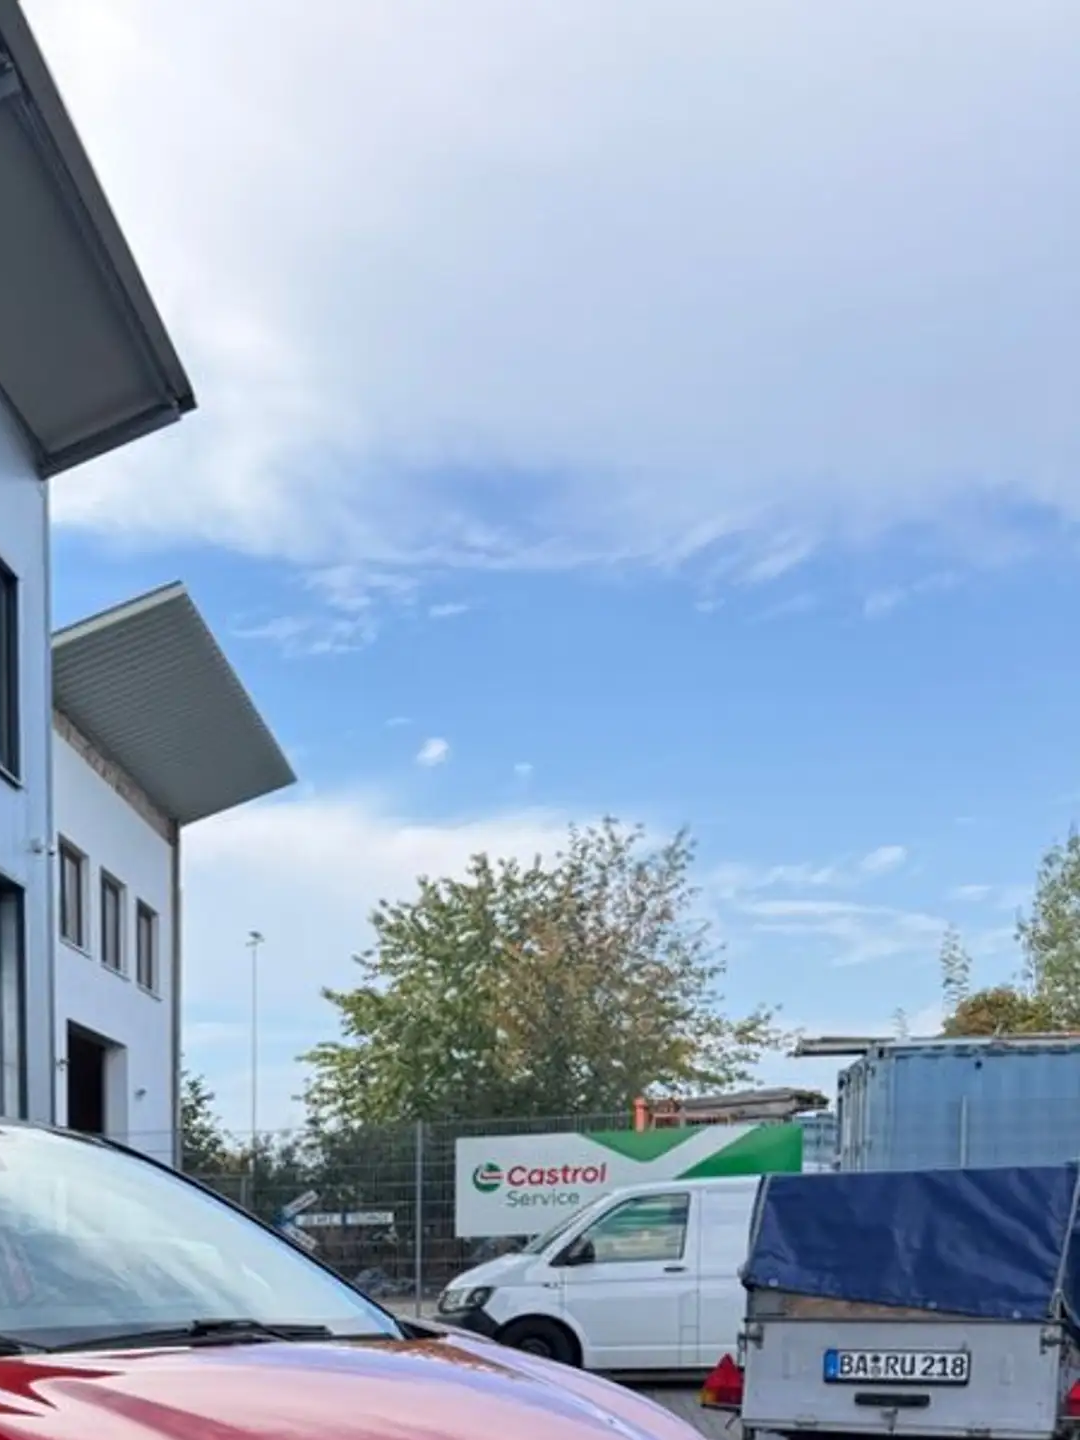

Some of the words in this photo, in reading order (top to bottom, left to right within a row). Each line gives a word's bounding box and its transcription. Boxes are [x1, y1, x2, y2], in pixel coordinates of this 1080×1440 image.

[506, 1162, 608, 1187] Castrol
[506, 1188, 580, 1208] Service
[921, 1355, 965, 1377] 218
